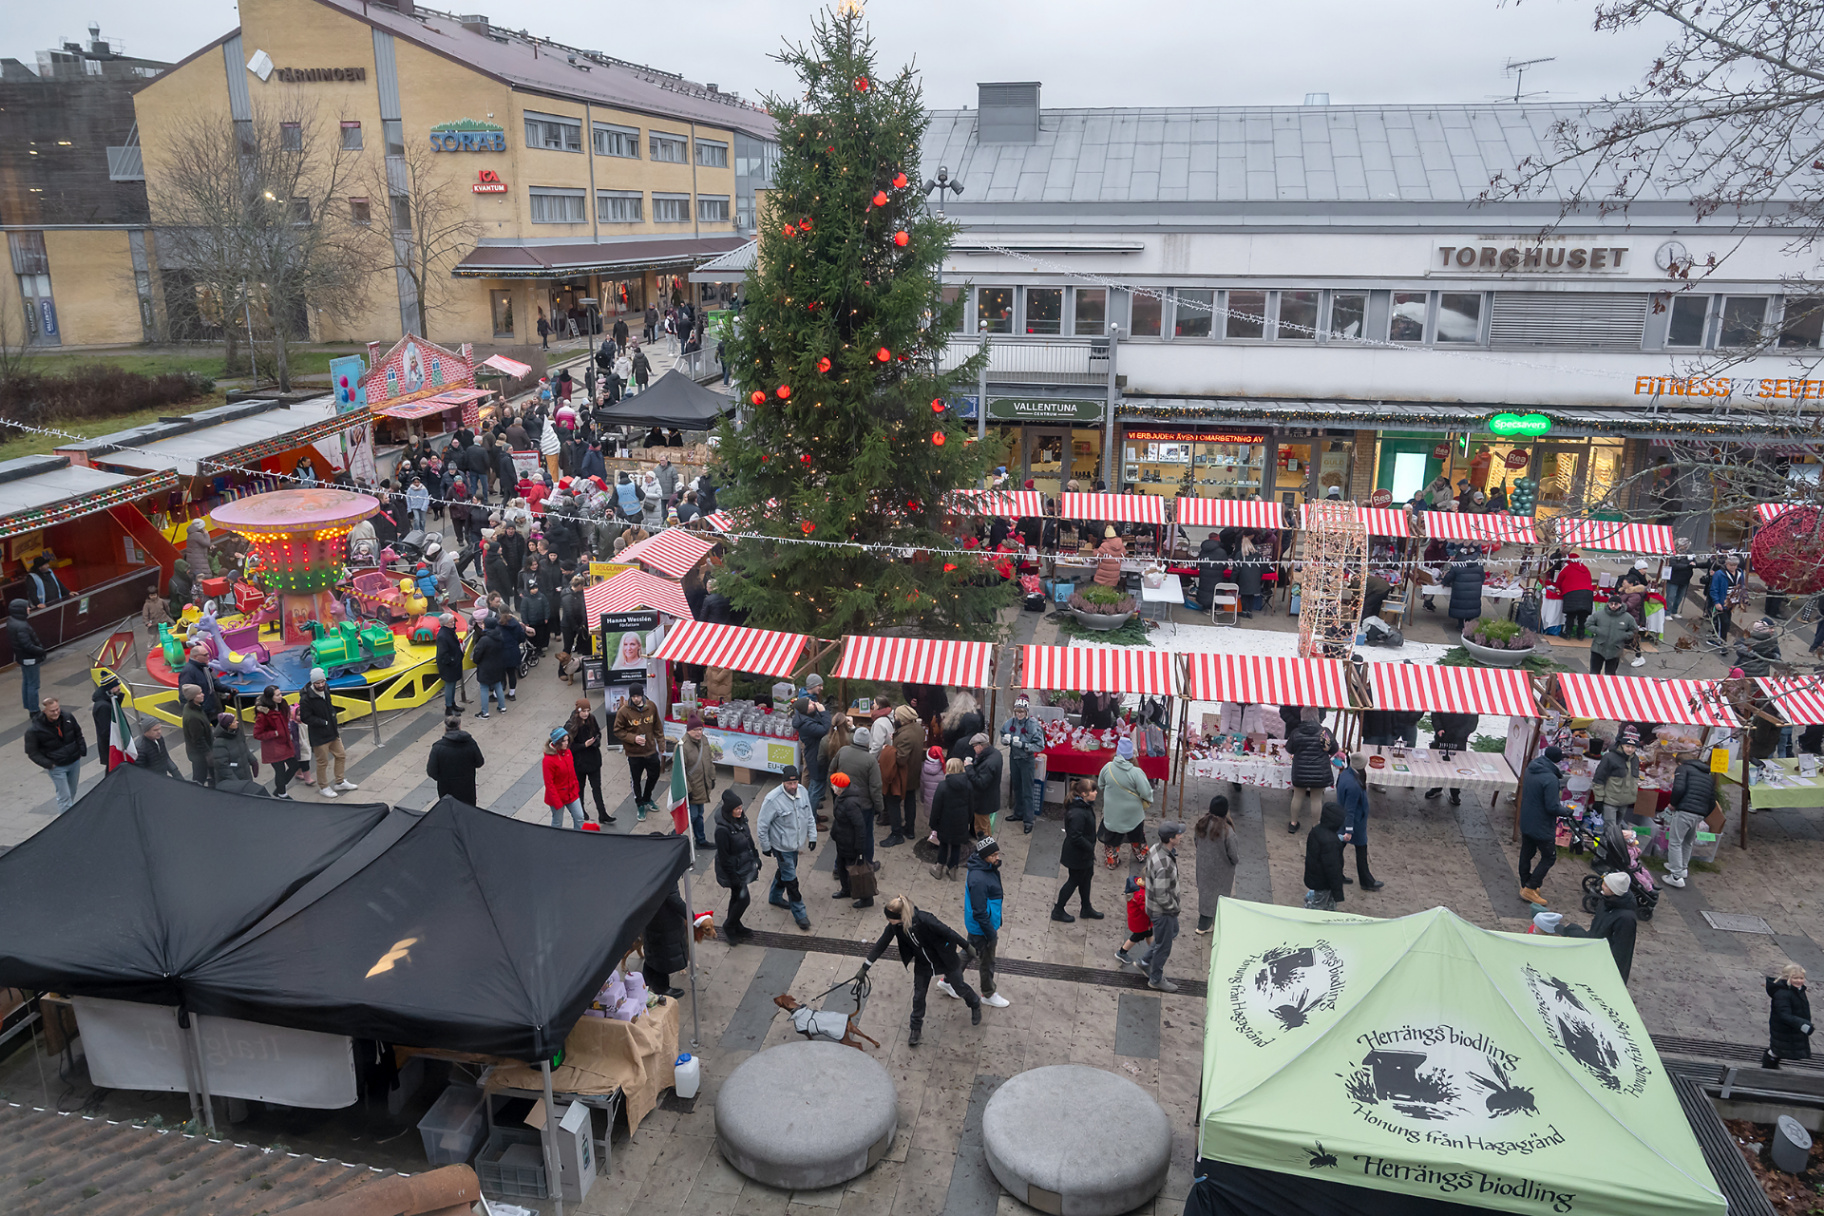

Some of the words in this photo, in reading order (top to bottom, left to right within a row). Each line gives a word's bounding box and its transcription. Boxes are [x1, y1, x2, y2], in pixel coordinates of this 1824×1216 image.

[275, 66, 366, 83] TÄRNINGEN
[429, 130, 507, 152] SÖRAB
[478, 170, 500, 182] ICA
[473, 184, 505, 192] KVANTUM
[1438, 245, 1629, 269] TORGHUSET
[1013, 402, 1078, 412] VALLENTUNA
[1494, 420, 1546, 430] Specsavers
[1136, 432, 1175, 440] ERBJUDER
[1435, 447, 1449, 455] Rea
[1508, 454, 1527, 462] Rea
[1373, 494, 1391, 503] Rea
[1228, 953, 1262, 986] Honung
[1230, 984, 1246, 1002] från
[1351, 1101, 1421, 1144] Honung
[1425, 1130, 1464, 1149] från
[1465, 1124, 1566, 1155] Hagagränd
[1472, 1169, 1576, 1213] biodling
